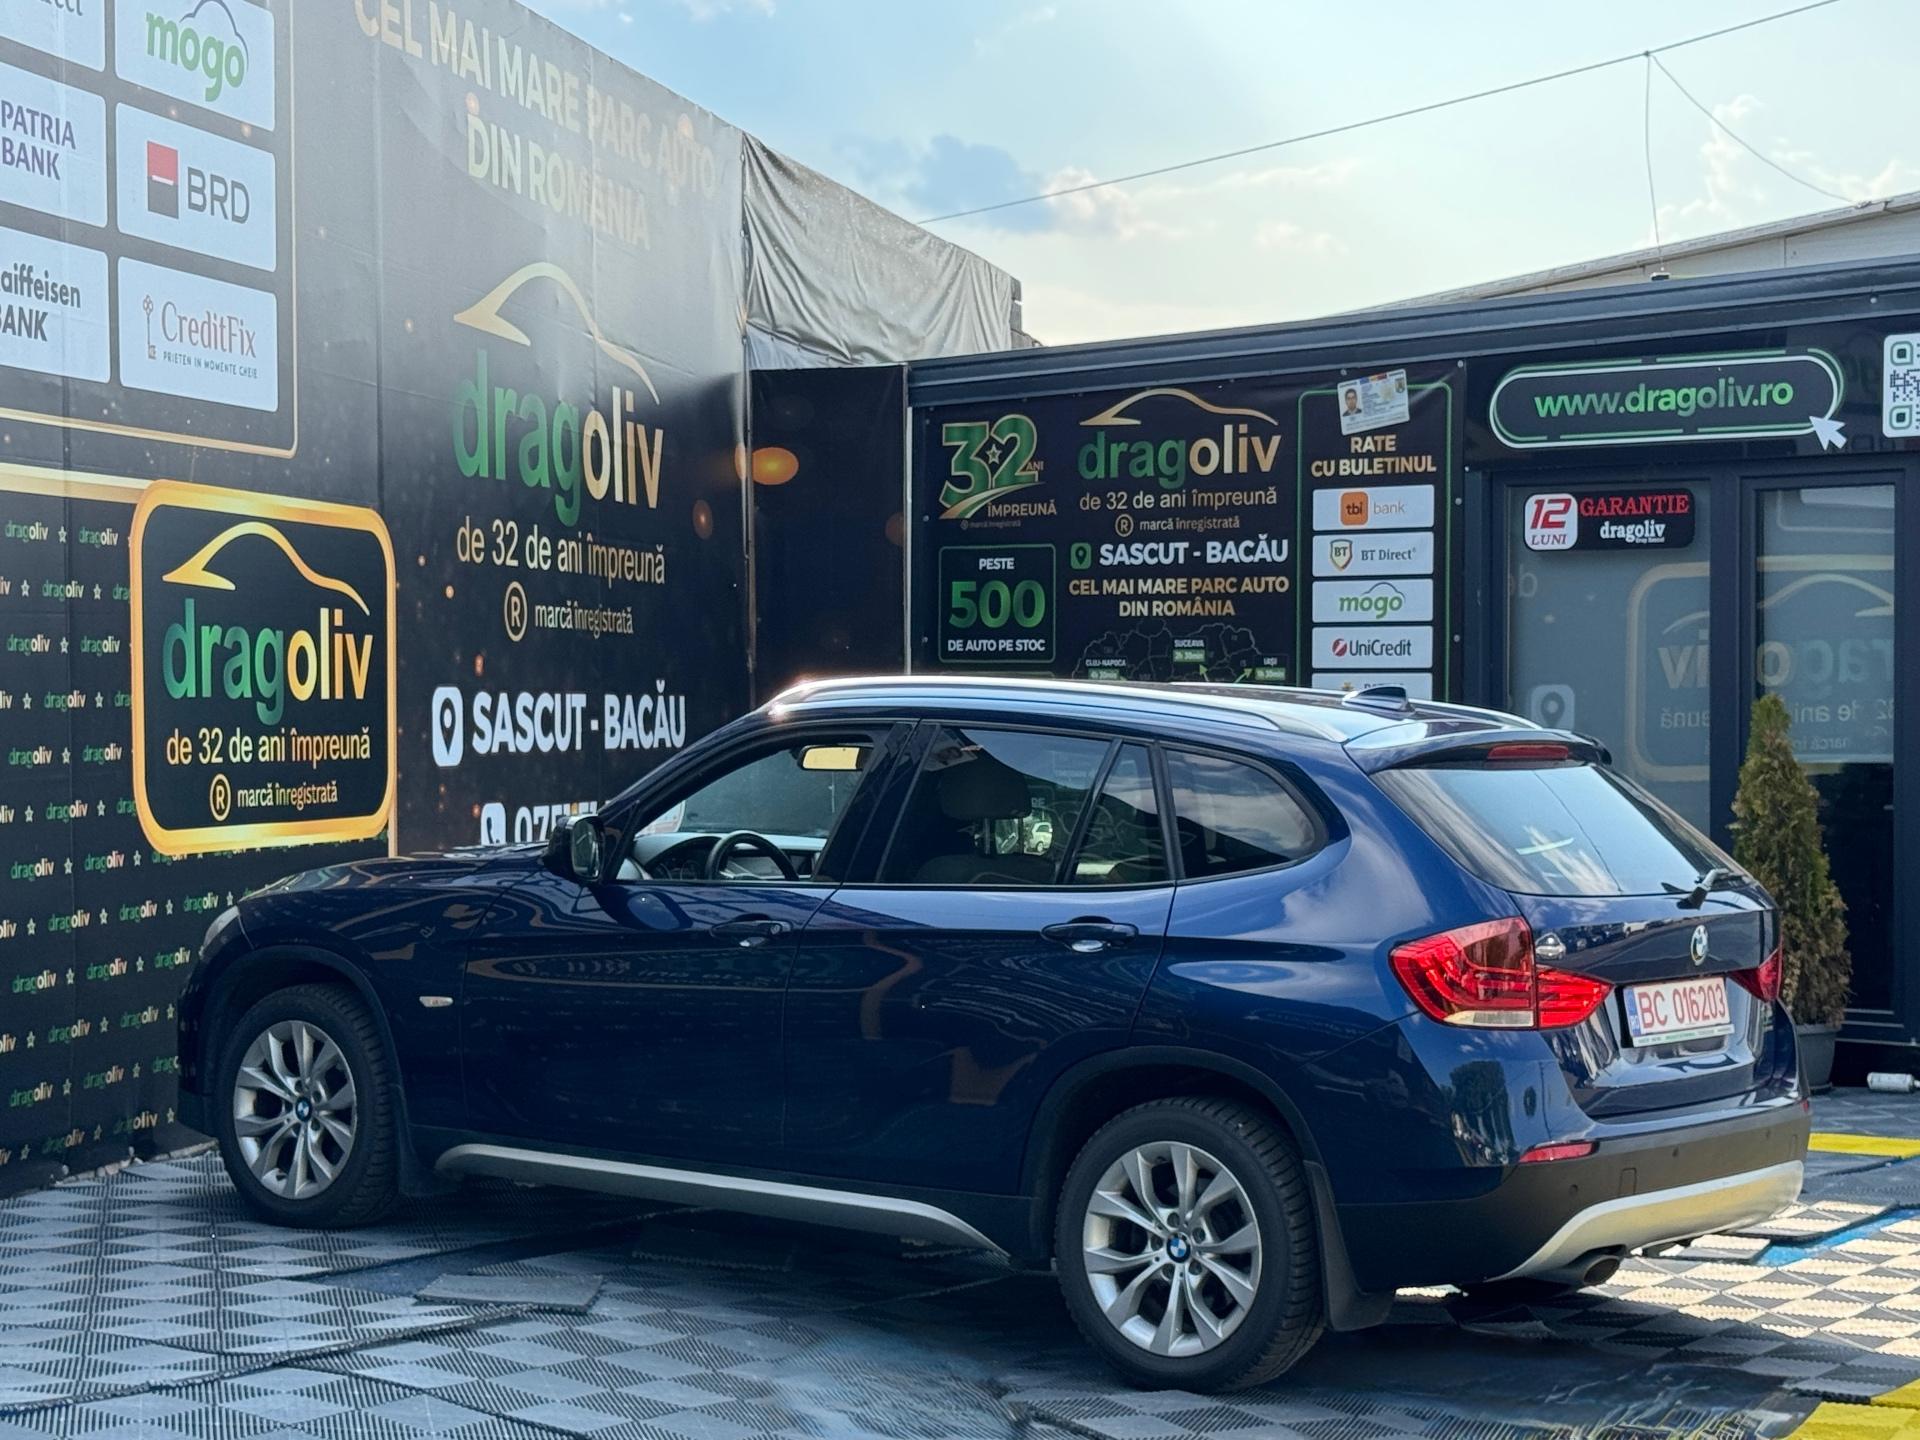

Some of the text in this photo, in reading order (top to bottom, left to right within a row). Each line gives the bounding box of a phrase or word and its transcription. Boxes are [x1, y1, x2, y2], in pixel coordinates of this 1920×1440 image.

[146, 12, 244, 101] mogo
[353, 0, 716, 199] CEL MAI MARE PARC AUTO
[1, 101, 76, 150] PATRIA
[2, 136, 61, 181] BANK
[467, 114, 522, 194] DIN
[187, 166, 250, 224] BRD
[0, 263, 81, 309] aiffeisen
[0, 303, 48, 342] ANK
[161, 301, 257, 358] CreditFix
[1534, 377, 1794, 417] www.dragoliv.ro
[452, 349, 664, 527] dragoliv
[1351, 435, 1396, 453] RATE
[939, 414, 1038, 508] 32
[1025, 461, 1044, 472] ANI
[1078, 424, 1281, 489] dragoliv
[1311, 455, 1437, 477] CU BULETINUL
[1079, 486, 1277, 510] de 32 de ani împreună
[1345, 502, 1405, 515] tbi bank
[1530, 498, 1572, 529] 12
[1580, 495, 1689, 517] GARANTIE
[5, 520, 119, 548] dragoliv dragoliv
[1139, 518, 1174, 531] marcă
[1175, 515, 1240, 532] înregistrată
[1600, 519, 1665, 542] dragoliv
[457, 516, 665, 588] de 32 de ani împreună
[1099, 541, 1190, 569] SASCUT
[1205, 533, 1289, 564] BACĂU
[1334, 546, 1348, 557] BT
[1361, 550, 1376, 561] BT
[1531, 534, 1567, 546] LUNI
[978, 557, 1015, 571] PESTE
[42, 580, 84, 602] dragoliv
[1068, 576, 1289, 597] CEL MAI MARE PARC AUTO
[534, 600, 572, 629] marcă
[573, 601, 634, 639] înregistrată
[949, 580, 1046, 629] 500
[1119, 597, 1235, 617] DIN ROMÂNIA
[1339, 596, 1402, 619] mogo
[7, 634, 120, 656] dragoliv dragoliv
[948, 638, 1045, 652] DE AUTO PE STOC
[1349, 639, 1411, 656] UniCredit
[162, 598, 373, 726] dragoliv
[44, 690, 86, 712] dragoliv
[472, 691, 586, 754] SASCUT
[604, 679, 685, 750] BACĂU
[8, 743, 122, 768] dragoliv dragoliv
[166, 726, 371, 769] de 32 de ani împreună
[237, 782, 274, 808] marcă
[275, 779, 339, 811] înregistrată
[46, 800, 88, 823] dragoliv
[10, 850, 125, 881] dragoliv dragoliv
[48, 909, 91, 933] dragoliv
[119, 900, 158, 923] dragoliv
[183, 892, 219, 913] dragoliv
[12, 947, 191, 994] dragoliv dragoliv dragoliv
[1637, 983, 1726, 1028] BC 016203
[48, 1018, 91, 1043] dragoliv
[120, 1006, 159, 1028] dragoliv
[9, 1081, 54, 1107] dragoliv
[83, 1065, 125, 1089] dragoliv
